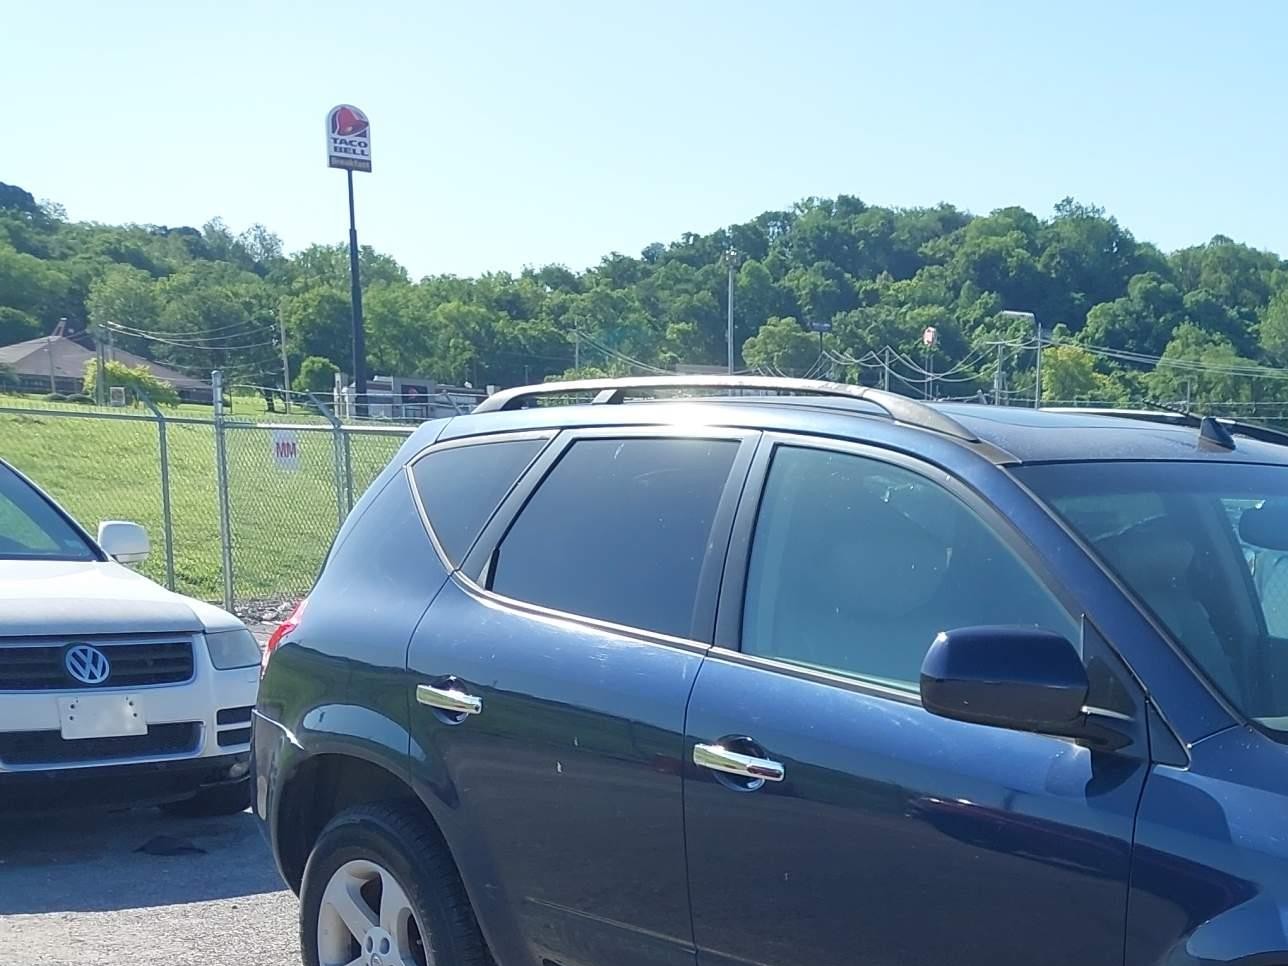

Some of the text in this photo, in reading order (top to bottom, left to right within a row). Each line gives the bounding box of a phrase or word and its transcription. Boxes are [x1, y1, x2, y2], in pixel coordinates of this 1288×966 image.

[331, 137, 369, 148] TACO
[334, 146, 369, 156] BELL
[276, 441, 297, 458] MM
